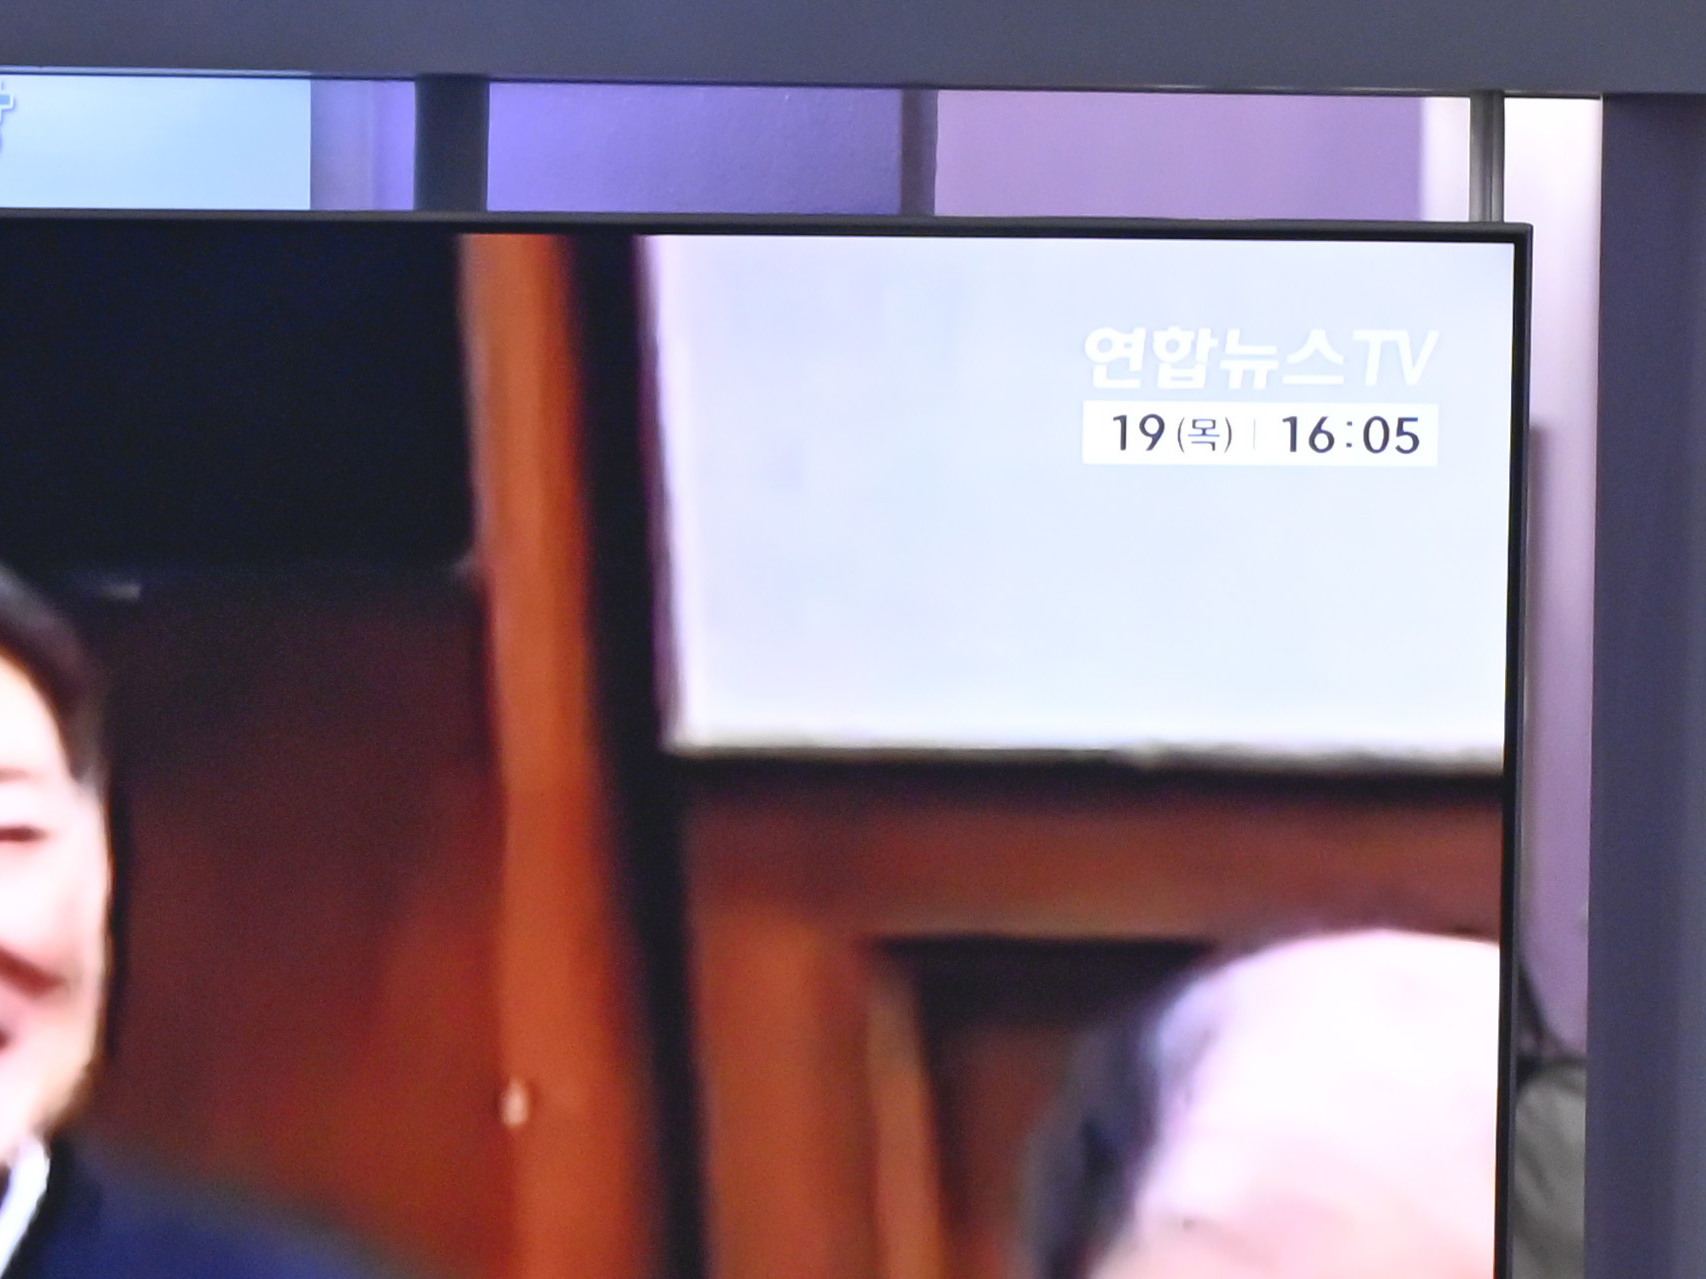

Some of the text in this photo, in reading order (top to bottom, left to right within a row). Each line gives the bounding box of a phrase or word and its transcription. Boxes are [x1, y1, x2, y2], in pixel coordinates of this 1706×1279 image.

[1084, 325, 1441, 390] 연합뉴스TV
[1111, 413, 1421, 455] 19(목) 16:05
